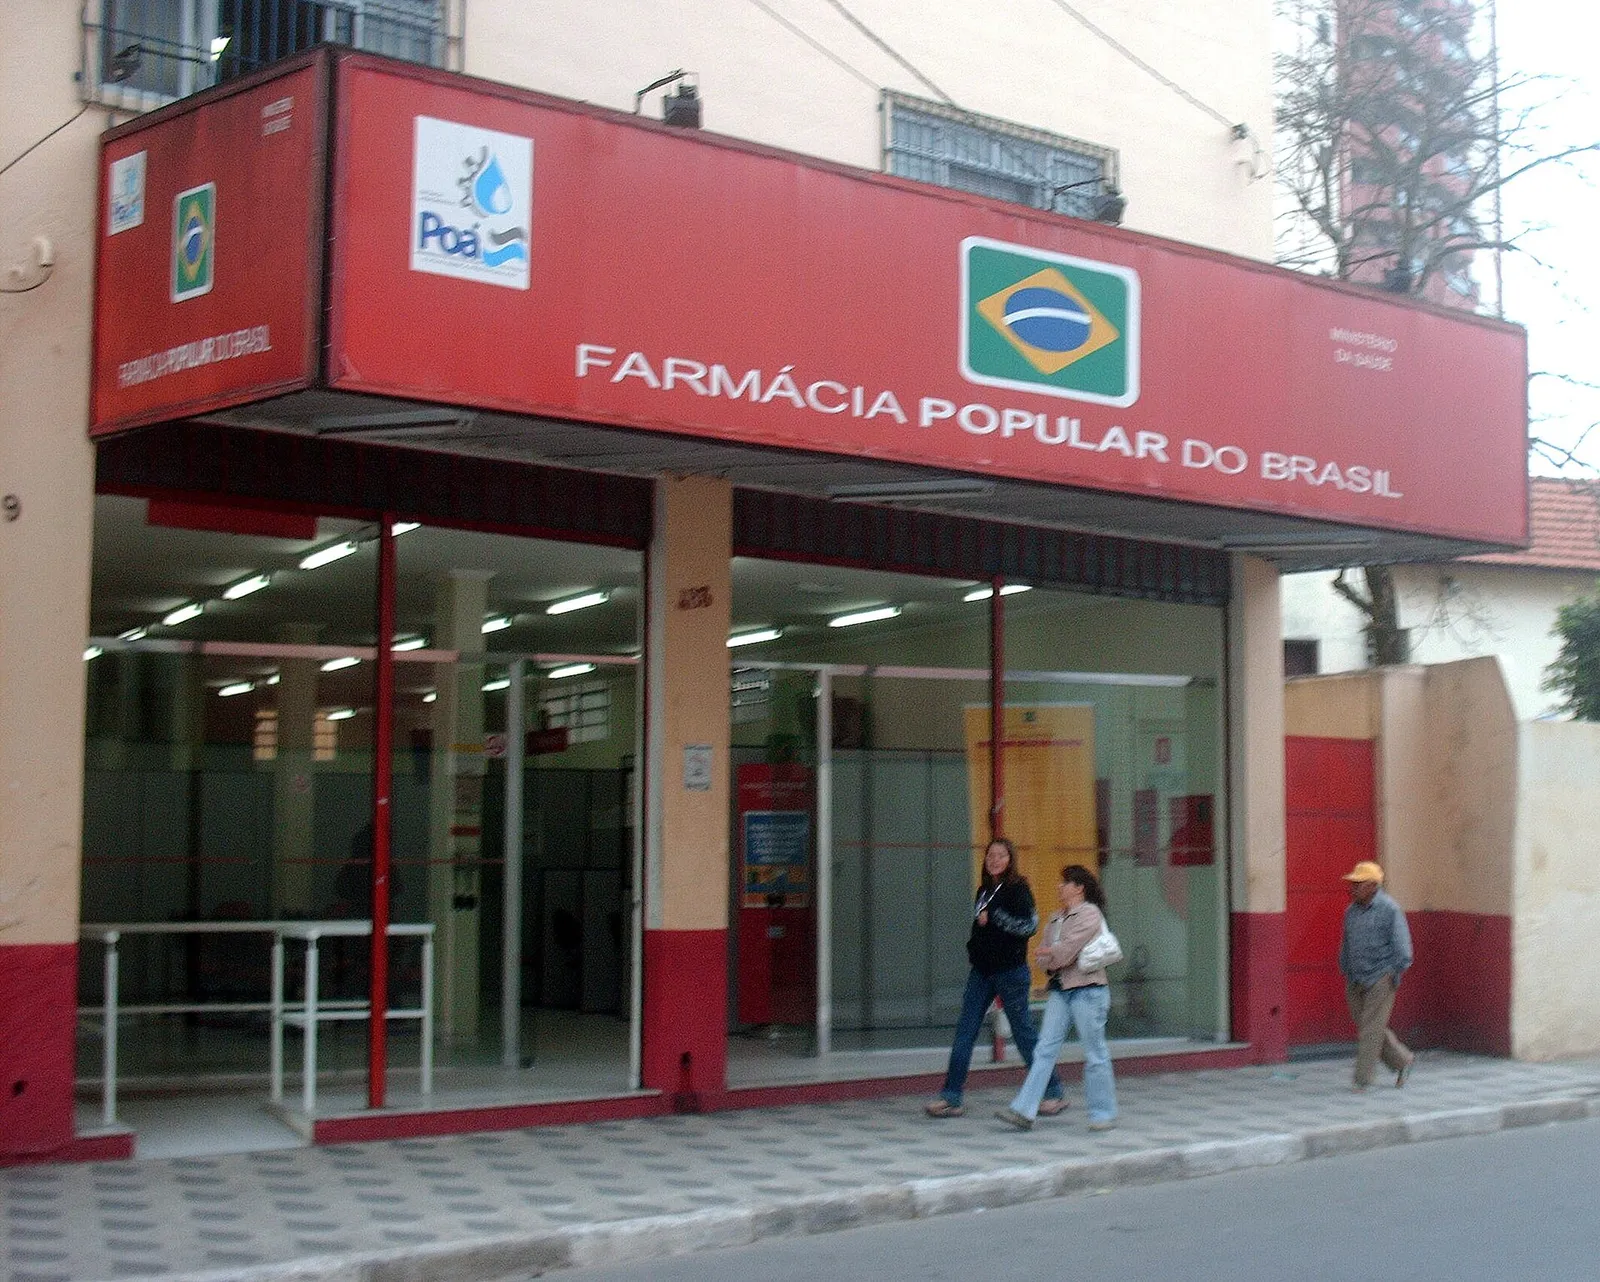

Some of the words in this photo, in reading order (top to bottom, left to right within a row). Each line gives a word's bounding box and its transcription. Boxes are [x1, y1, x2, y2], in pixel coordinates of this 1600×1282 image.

[419, 210, 481, 259] Poá
[574, 342, 909, 424] FARMÁCIA
[918, 396, 1170, 463] POPULAR
[1181, 438, 1249, 474] DO
[1260, 451, 1404, 498] BRASIL
